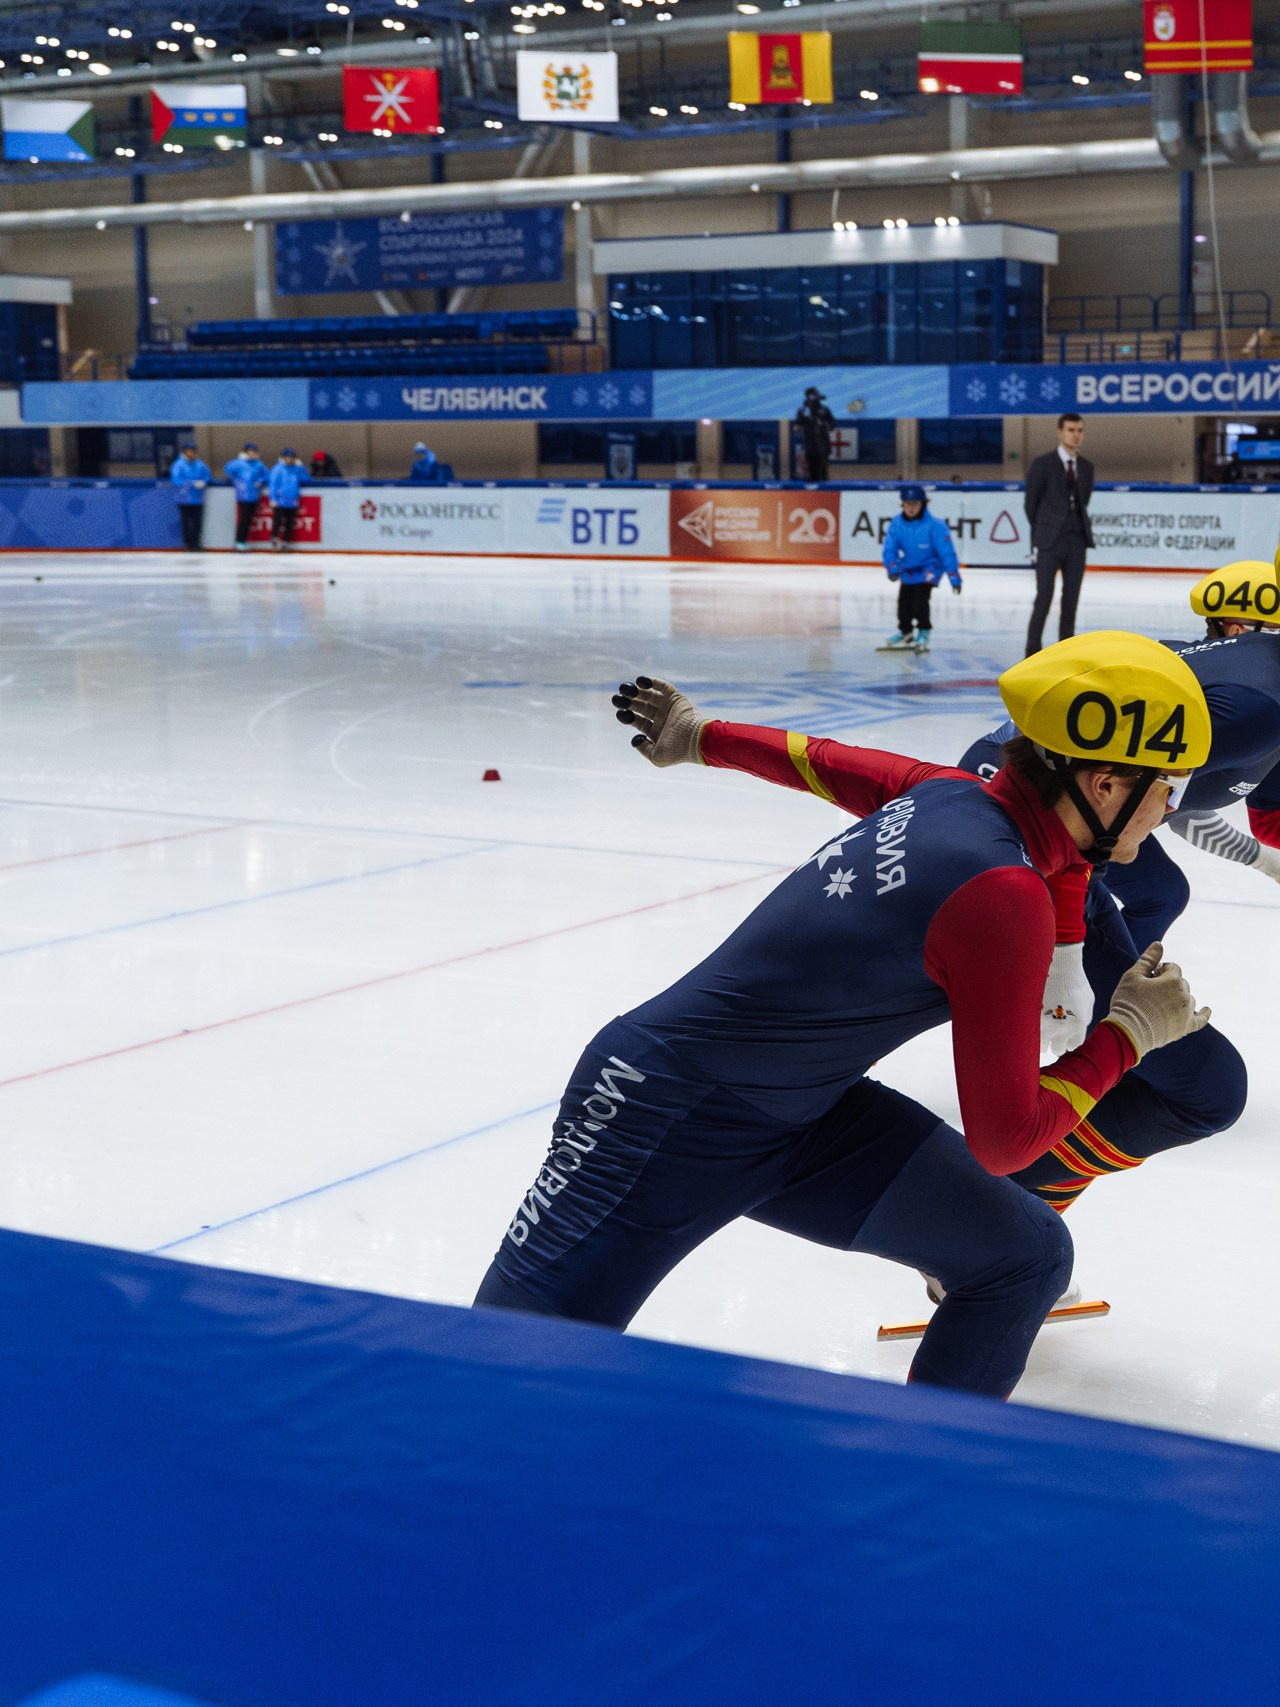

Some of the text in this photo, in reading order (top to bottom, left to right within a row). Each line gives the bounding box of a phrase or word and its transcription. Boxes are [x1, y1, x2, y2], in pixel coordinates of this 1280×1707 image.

[402, 386, 548, 412] ЧЕЛЯБИНСК
[380, 503, 500, 520] РОСКОНГРЕСС
[571, 508, 640, 546] ВТБ
[788, 508, 836, 543] 20
[852, 510, 982, 545] Арнт
[1179, 515, 1221, 529] СПОРТА
[1094, 530, 1160, 548] ОССИЙСКОЙ
[1202, 580, 1280, 615] 040
[1066, 690, 1188, 763] 014
